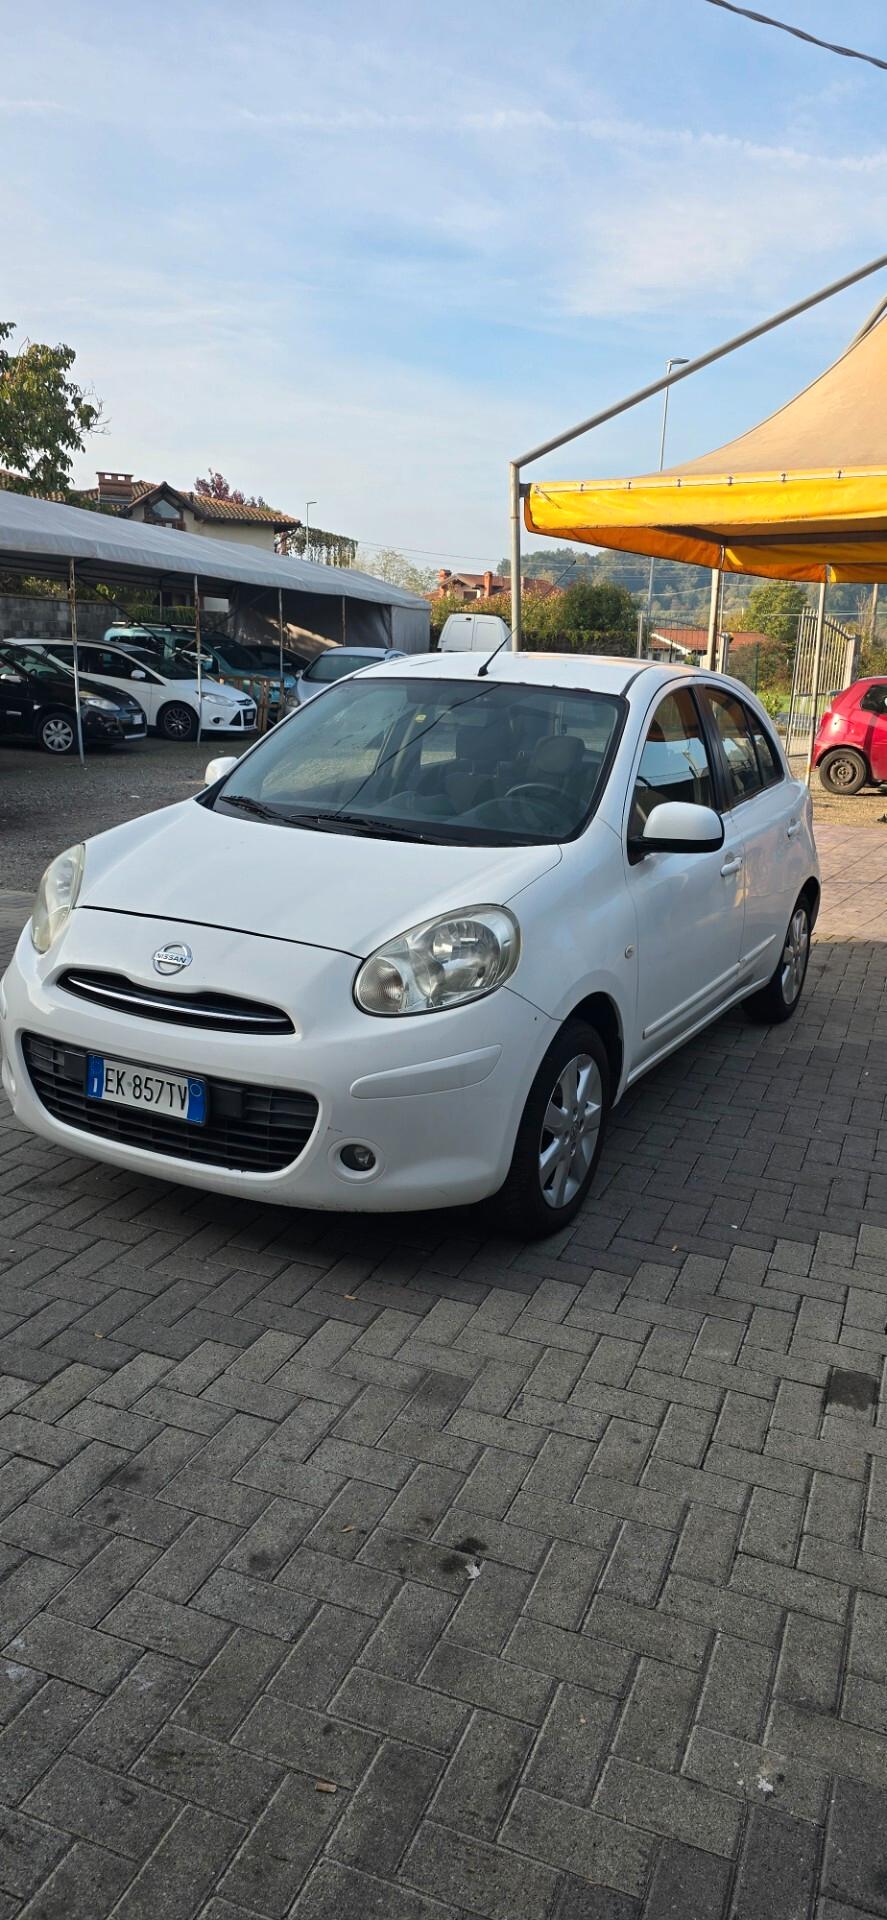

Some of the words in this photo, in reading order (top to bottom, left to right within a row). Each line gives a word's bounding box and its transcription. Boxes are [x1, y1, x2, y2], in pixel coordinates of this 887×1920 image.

[157, 952, 187, 964] NISSAN
[104, 1067, 126, 1096] EK
[132, 1074, 188, 1110] 857TV
